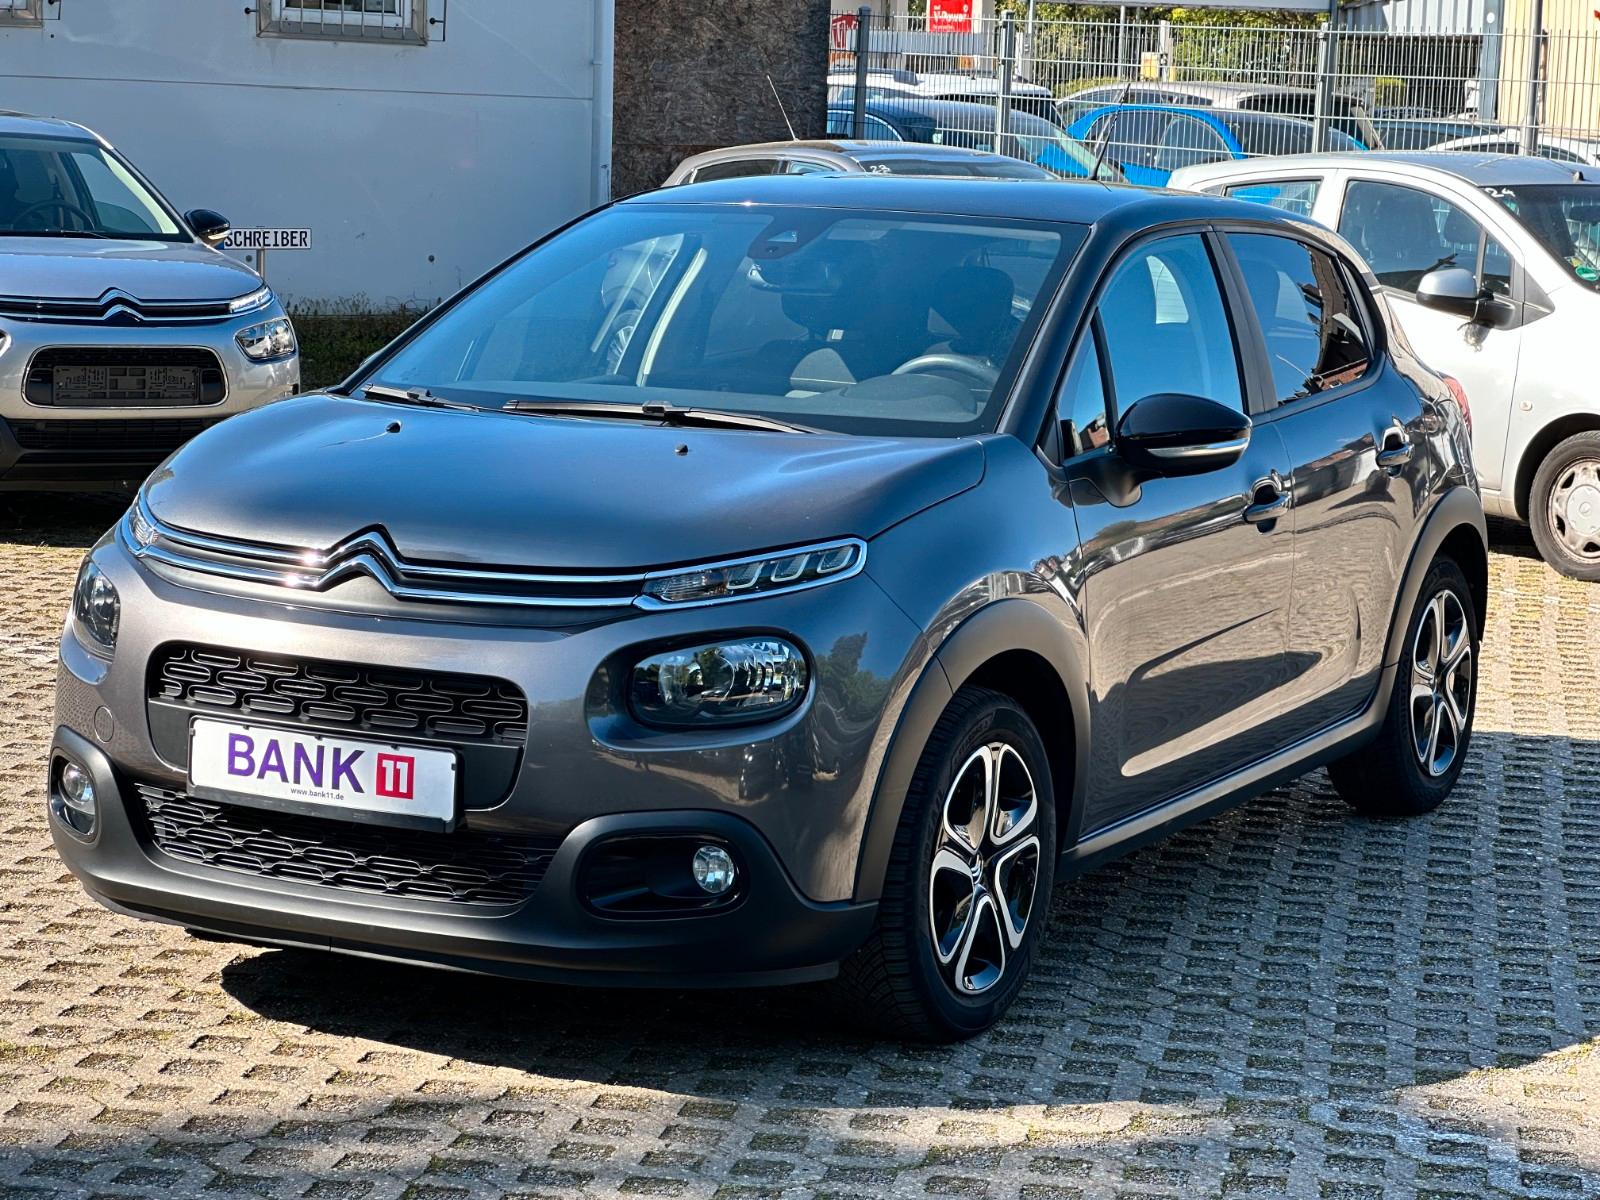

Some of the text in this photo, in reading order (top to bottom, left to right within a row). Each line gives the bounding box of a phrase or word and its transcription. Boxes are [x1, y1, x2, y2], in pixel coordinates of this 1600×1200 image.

[224, 230, 308, 247] SCHREIBER
[227, 732, 409, 794] BANK 11
[290, 786, 345, 801] www.bank11.de
